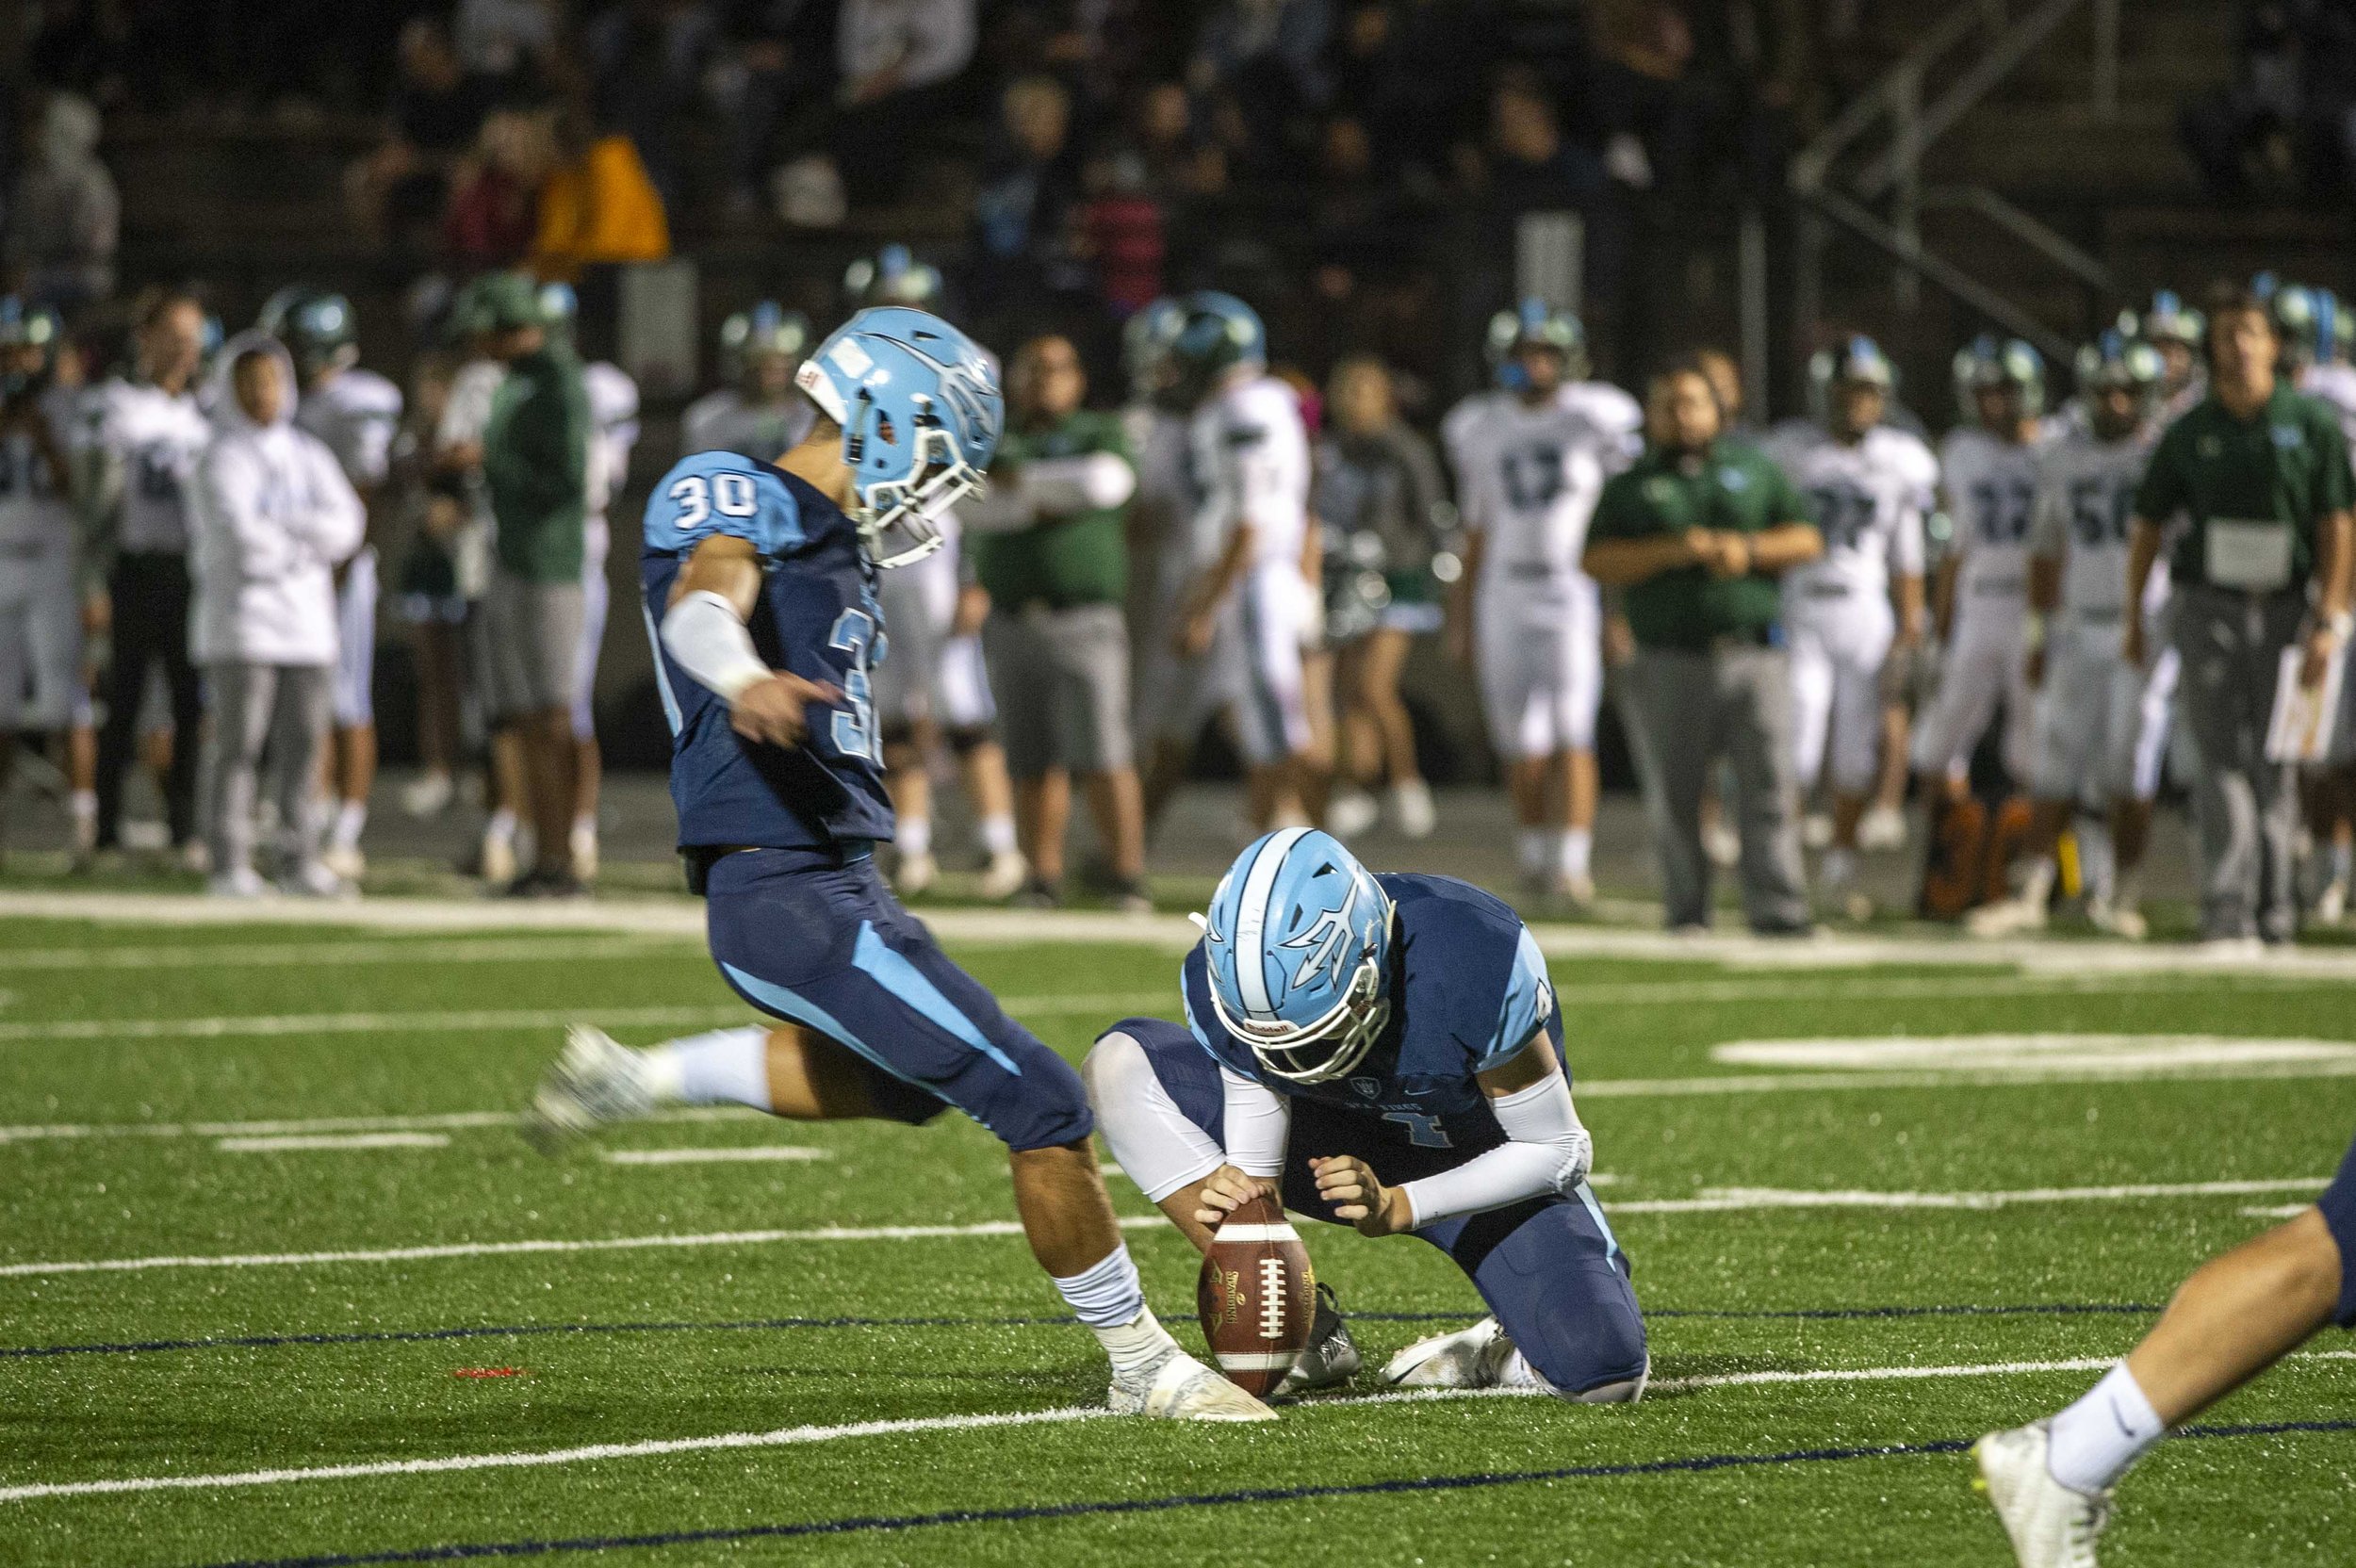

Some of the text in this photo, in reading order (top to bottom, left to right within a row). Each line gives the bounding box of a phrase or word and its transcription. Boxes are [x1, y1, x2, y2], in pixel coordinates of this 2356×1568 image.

[669, 474, 759, 530] 30
[827, 607, 888, 770] 3
[1226, 1270, 1239, 1324] SPALDING
